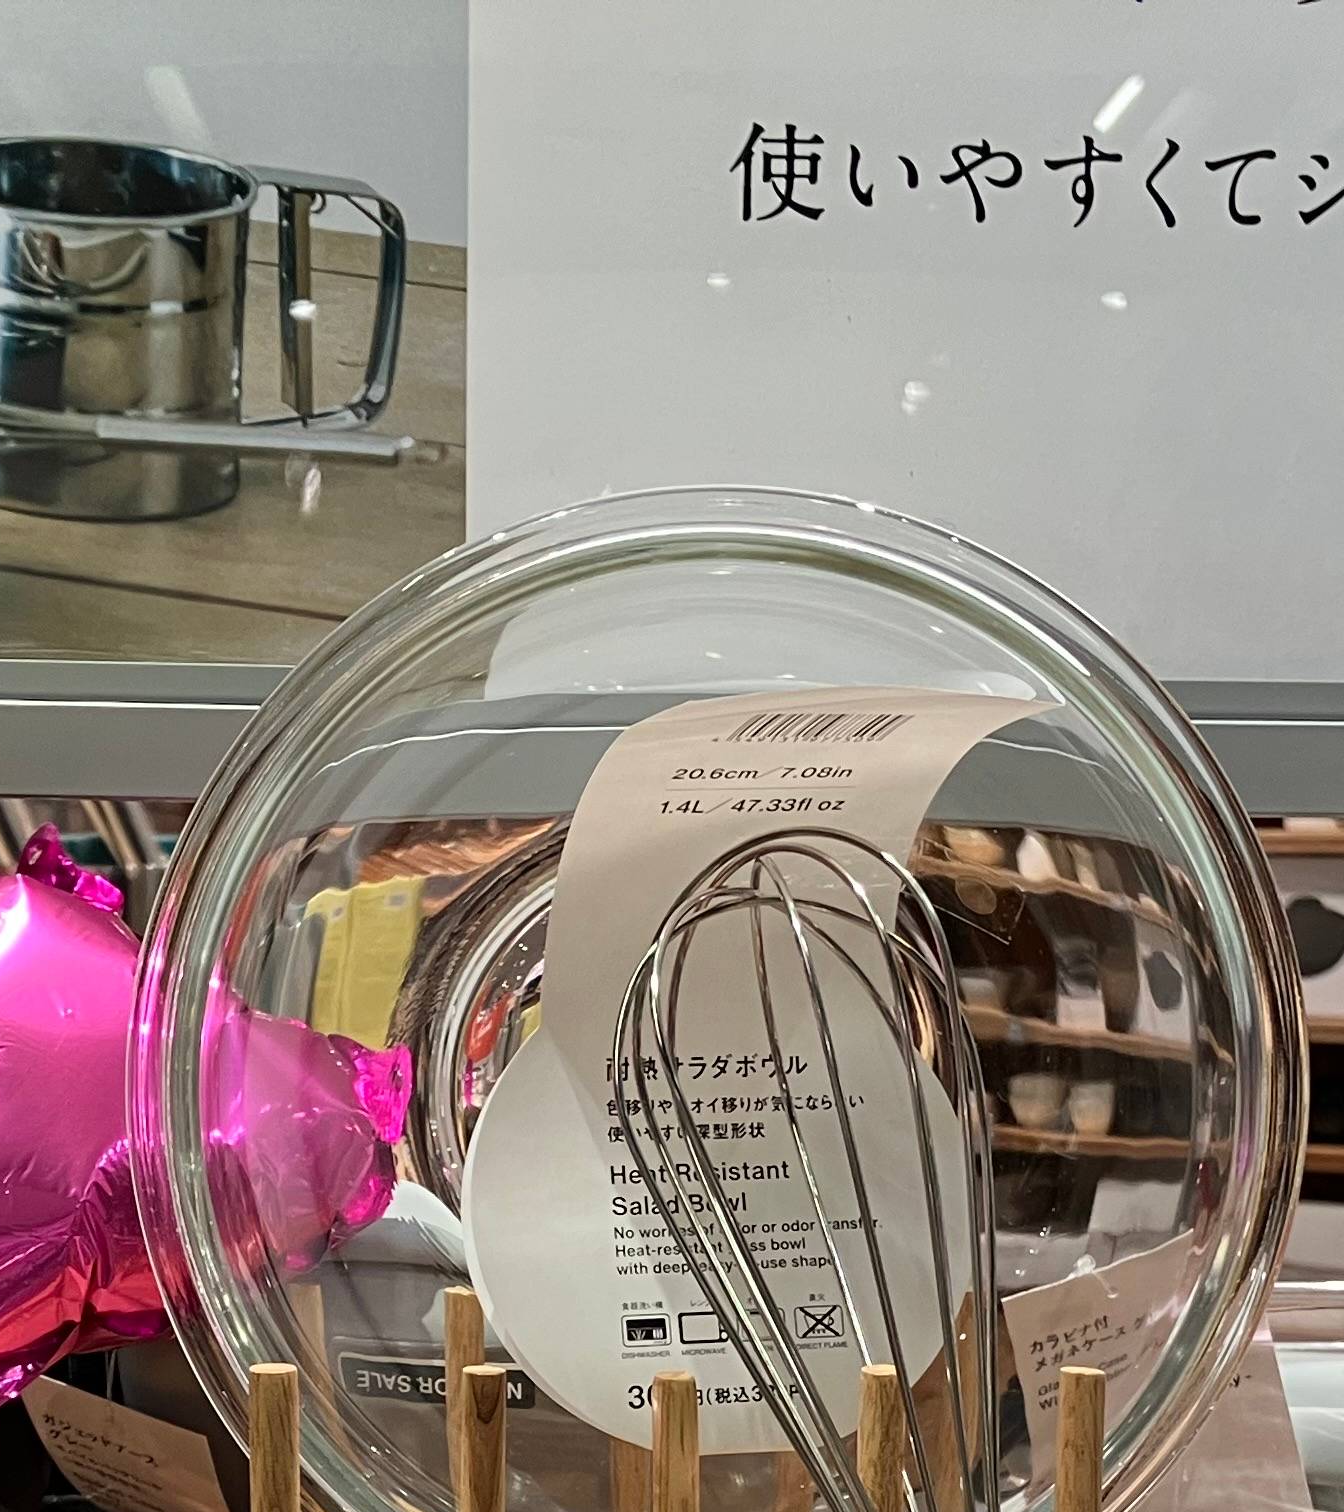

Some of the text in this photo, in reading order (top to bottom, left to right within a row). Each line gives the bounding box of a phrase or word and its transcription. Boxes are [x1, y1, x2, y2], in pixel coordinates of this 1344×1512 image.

[817, 800, 846, 811] oz
[614, 1227, 634, 1239] No
[762, 1223, 776, 1233] or
[782, 1220, 815, 1232] odor
[771, 1237, 806, 1250] bowl
[617, 1263, 648, 1275] with
[356, 1369, 411, 1393] SALE
